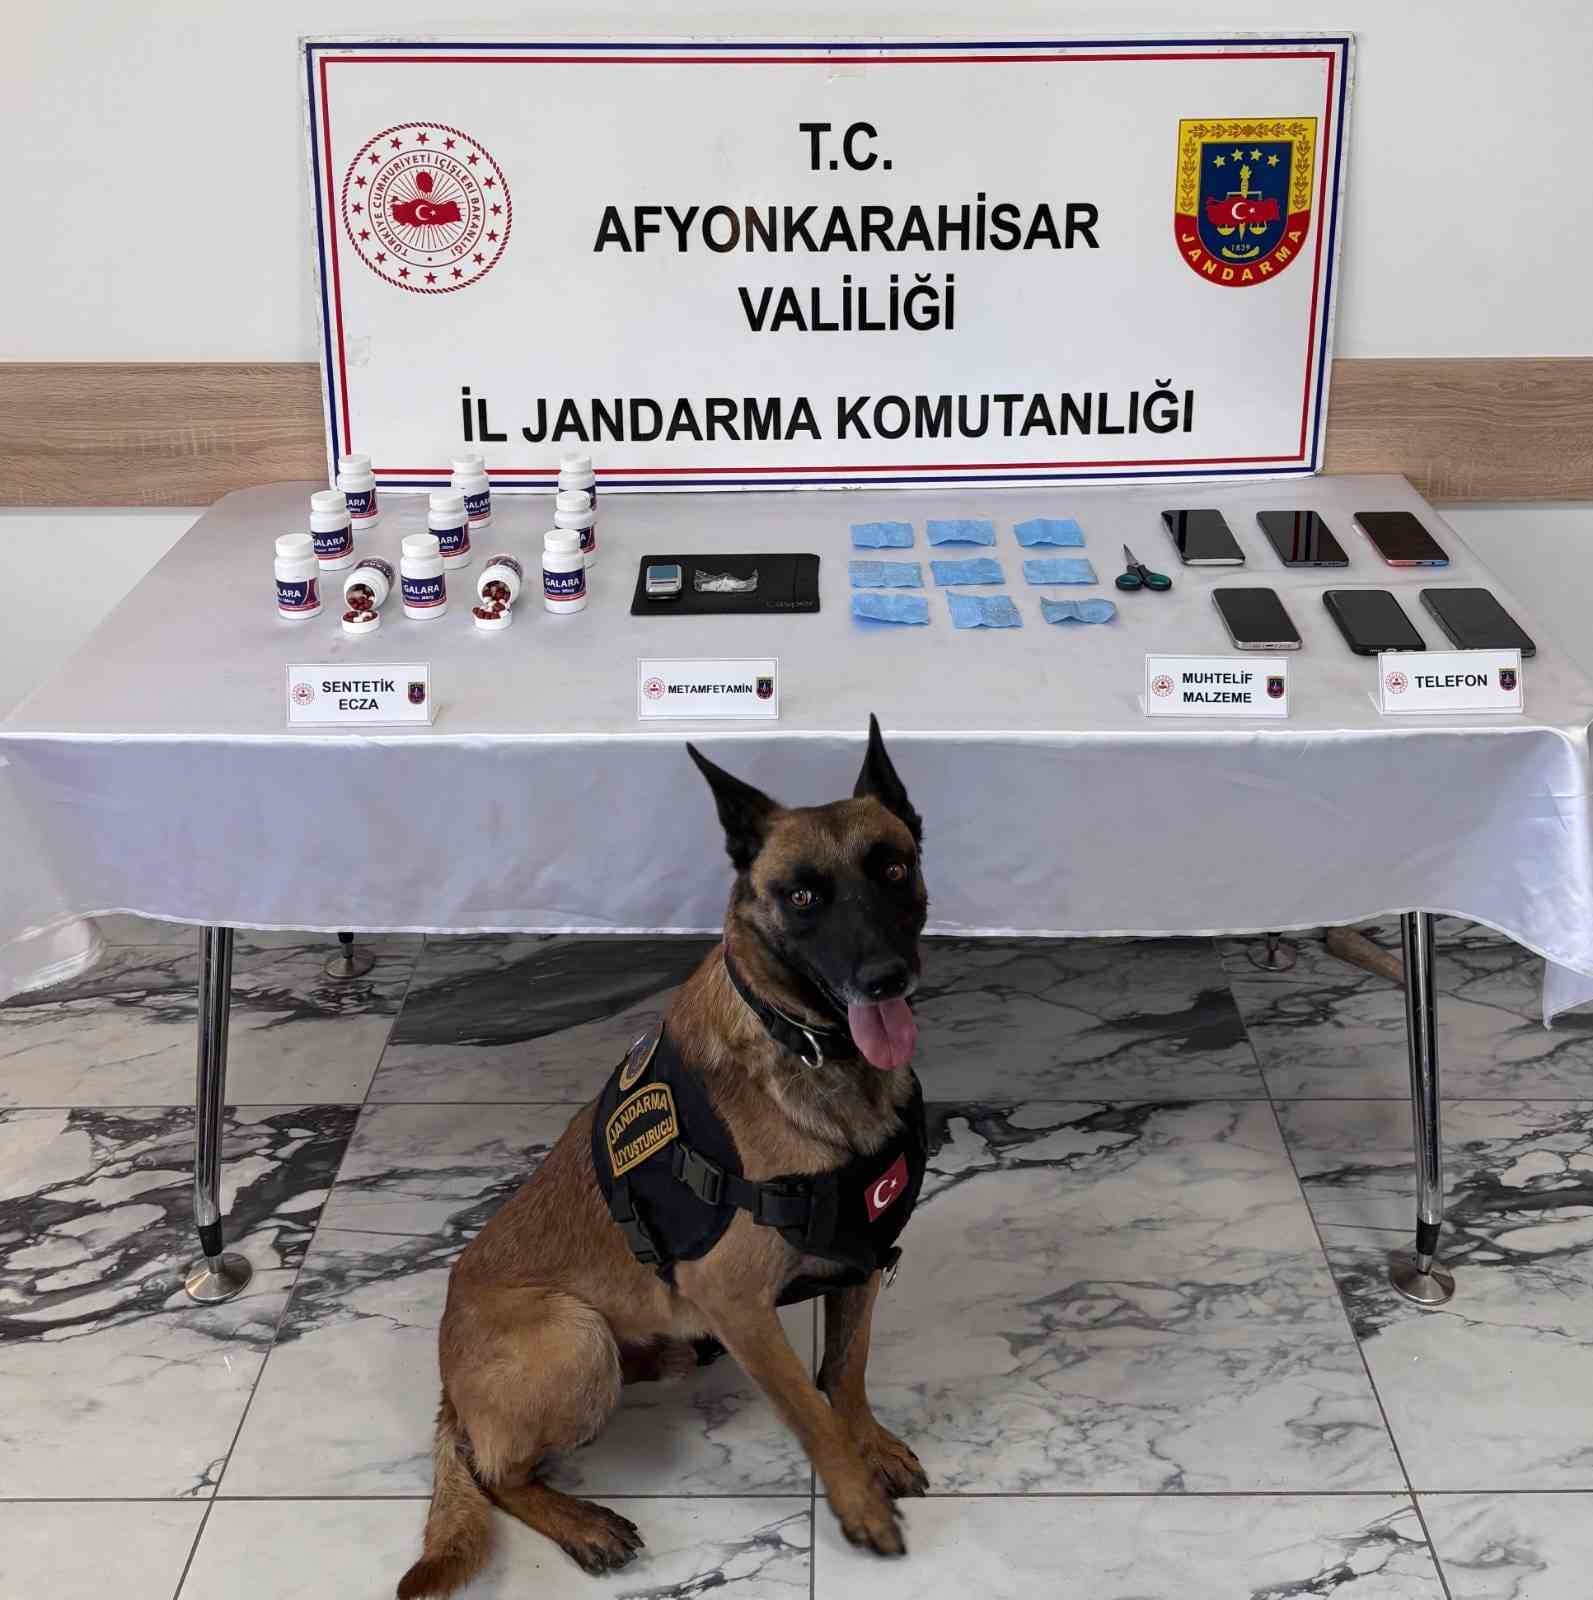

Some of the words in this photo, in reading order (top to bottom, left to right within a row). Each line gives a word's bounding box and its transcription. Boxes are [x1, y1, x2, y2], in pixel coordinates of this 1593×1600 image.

[800, 122, 891, 170] T.C.
[372, 153, 431, 209] CUMHURİYETİ
[434, 154, 475, 195] İÇİŞLERİ
[372, 212, 409, 257] TÜRKİYE
[451, 198, 482, 258] BAKANLIĞI
[594, 192, 1099, 252] AFYONKARAHİSAR
[1182, 229, 1303, 281] JANDARMA
[738, 273, 954, 331] VALİLİĞİ
[462, 385, 507, 442] İL
[523, 393, 821, 442] JANDARMA
[838, 379, 1193, 440] KOMUTANLIĞI
[403, 583, 440, 595] GALARA
[544, 577, 580, 588] GALARA
[322, 679, 395, 693] SENTETİK
[668, 683, 753, 694] METAMFETAMİN
[1182, 670, 1253, 685] MUHTELİF
[1183, 691, 1252, 704] MALZEME
[1414, 674, 1488, 690] TELEFON
[339, 698, 379, 711] ECZA
[609, 1092, 668, 1145] JANDARMA
